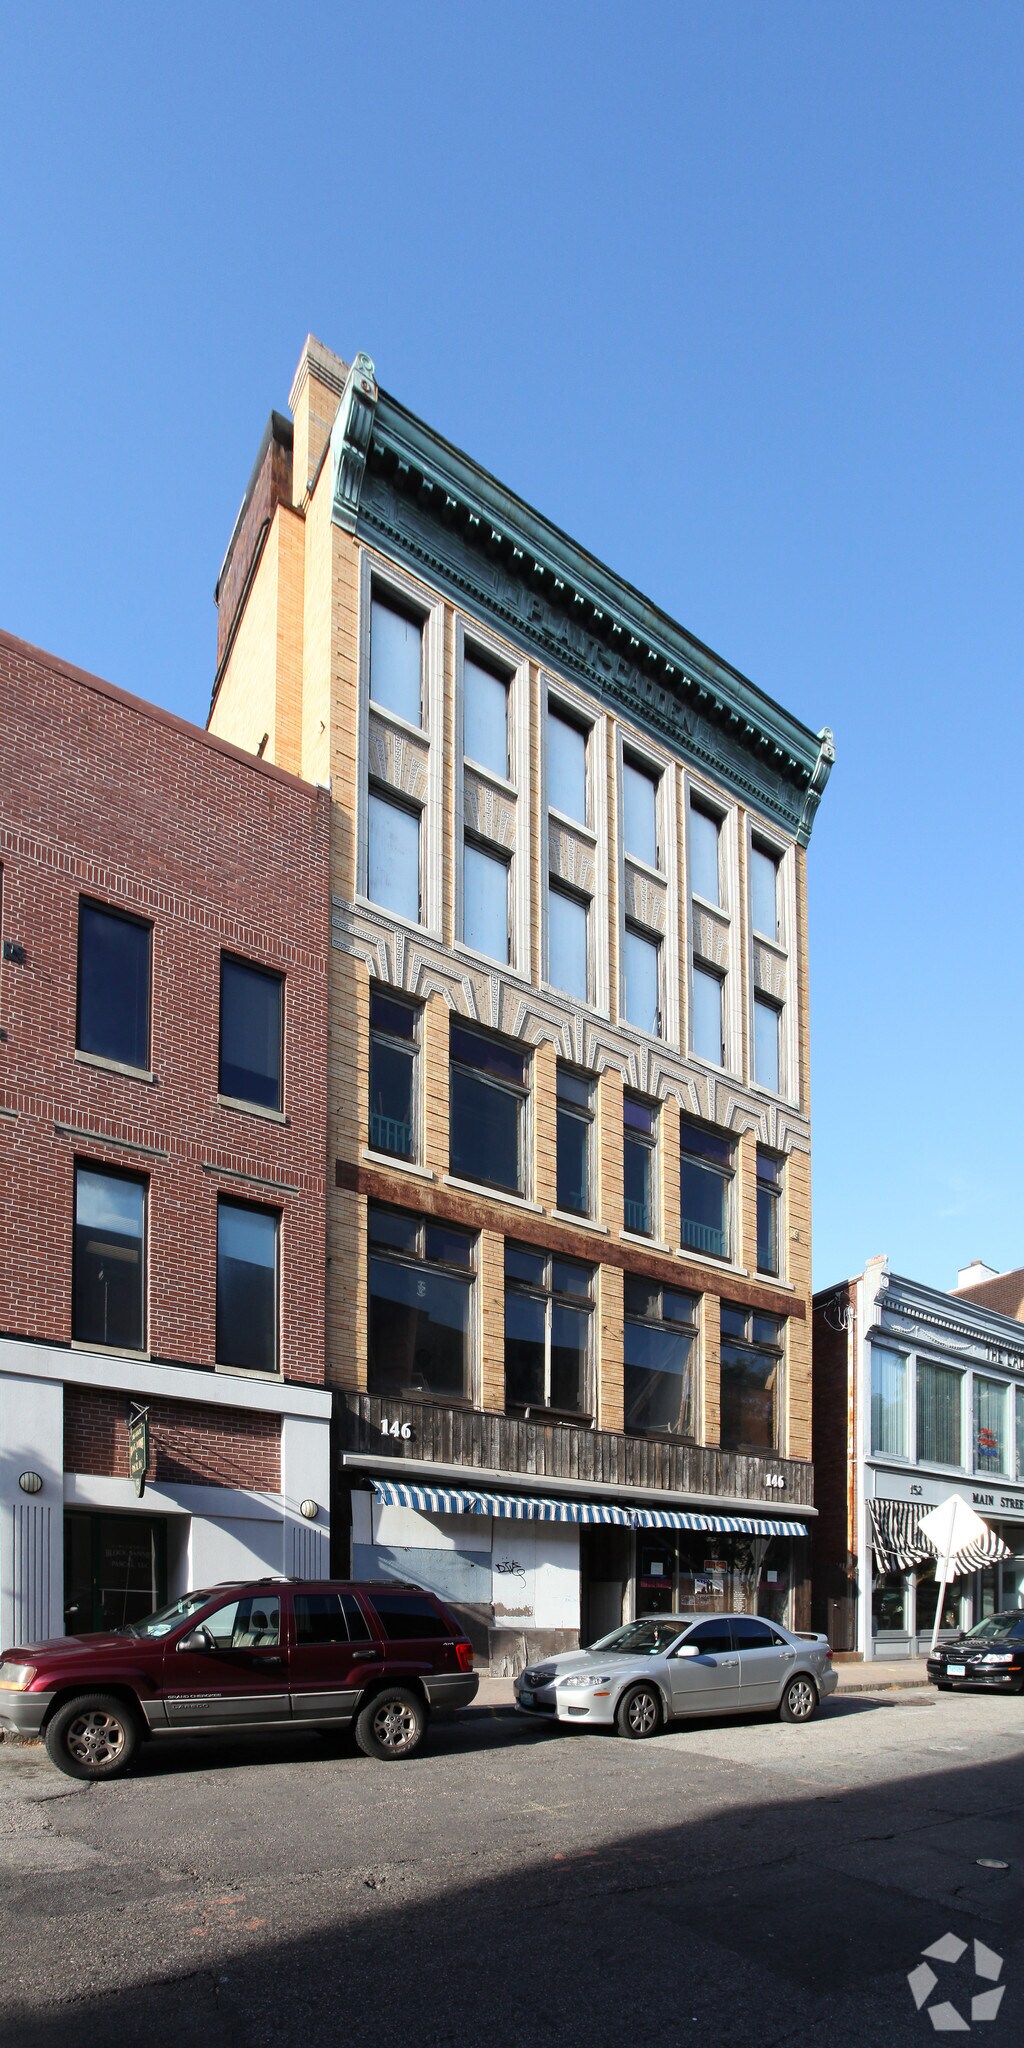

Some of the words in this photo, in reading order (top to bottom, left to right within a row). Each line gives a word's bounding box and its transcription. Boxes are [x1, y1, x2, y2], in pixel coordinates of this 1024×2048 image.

[986, 1346, 1003, 1364] THE
[380, 1419, 412, 1439] 146
[766, 1474, 784, 1488] 146
[910, 1485, 923, 1496] 152
[972, 1492, 994, 1506] MAIN
